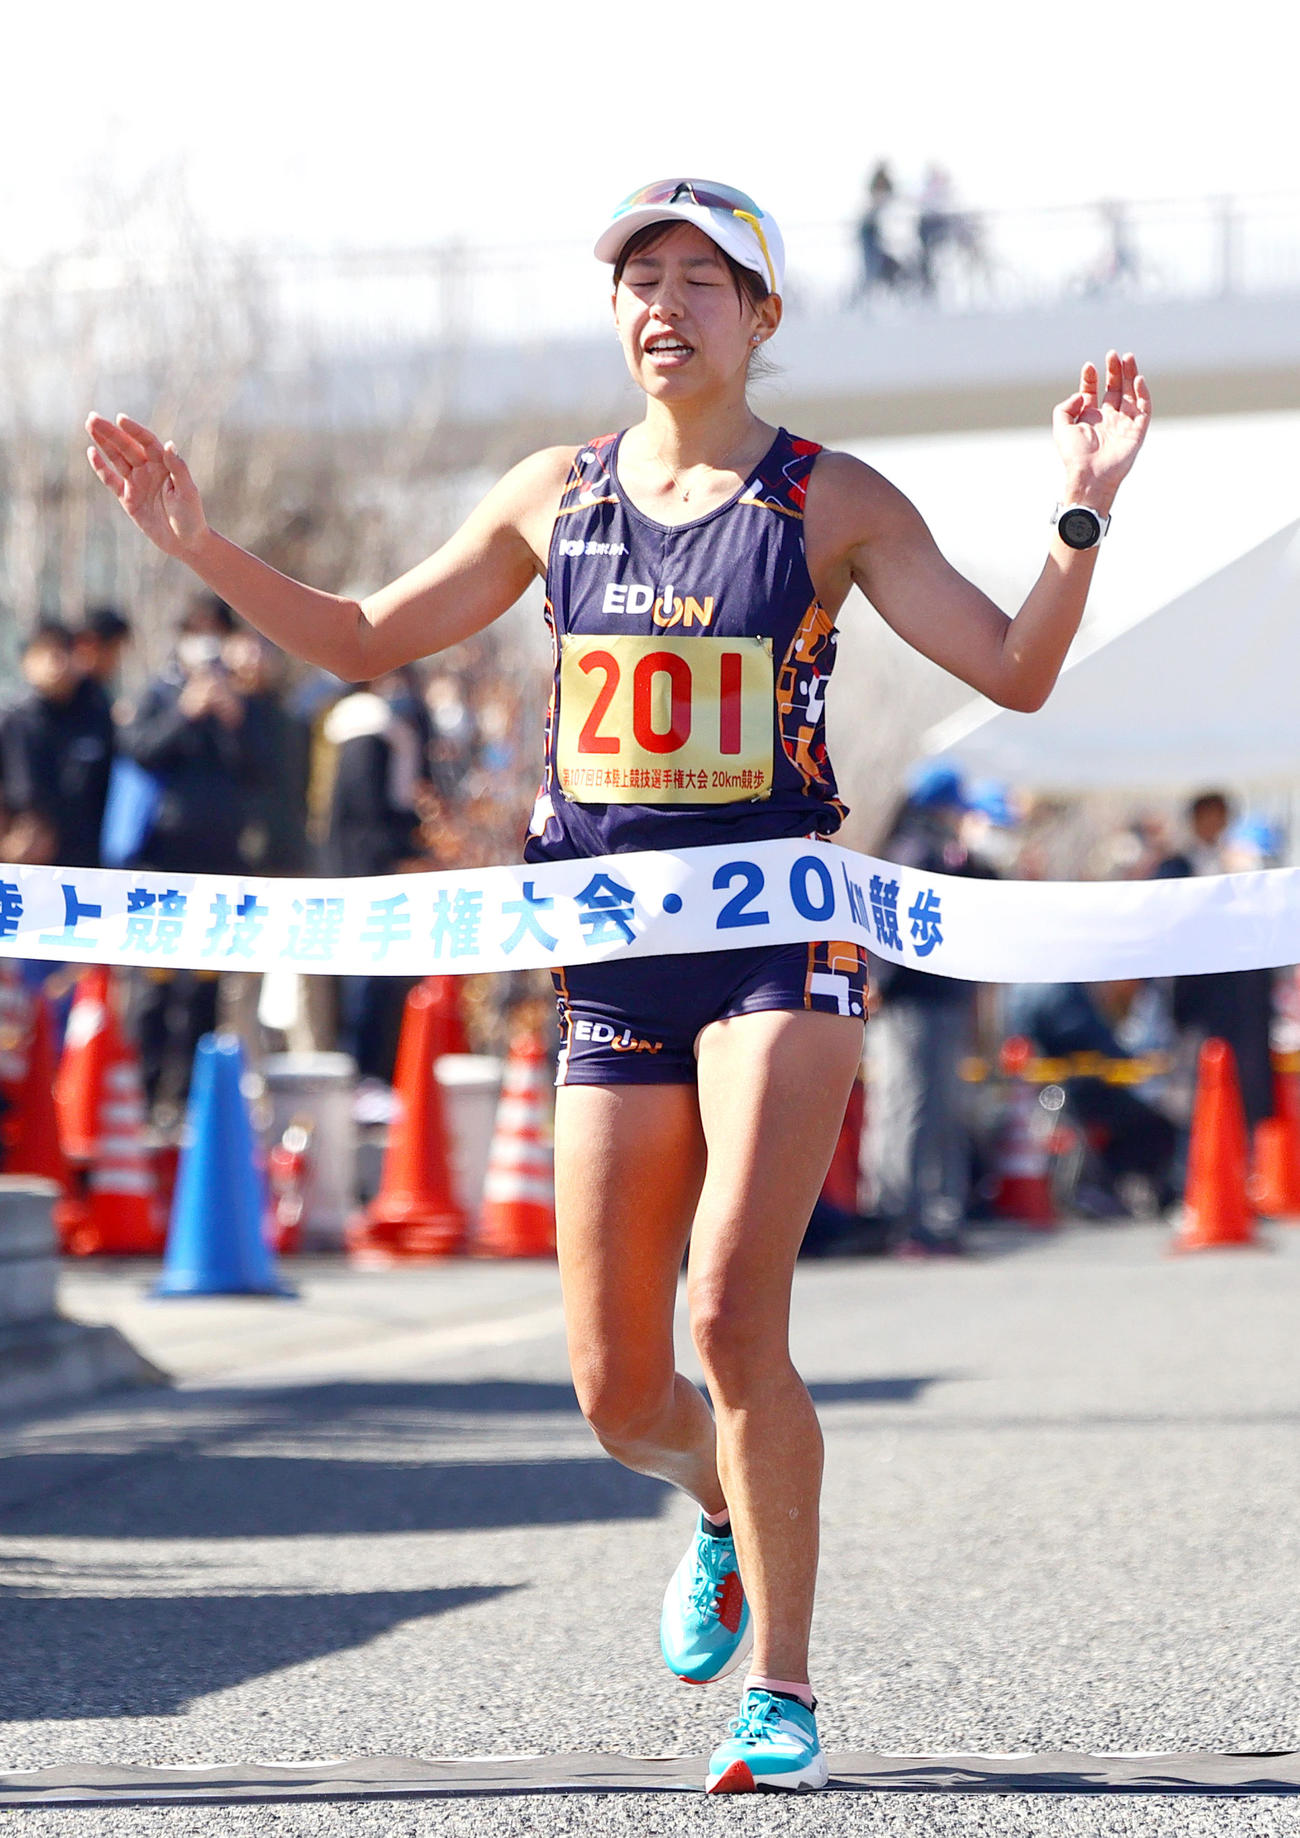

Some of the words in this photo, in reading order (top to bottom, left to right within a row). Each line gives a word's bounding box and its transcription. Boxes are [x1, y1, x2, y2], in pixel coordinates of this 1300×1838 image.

[602, 583, 714, 627] EDION
[577, 650, 742, 755] 201
[563, 768, 708, 790] 第107回日本陸上競技選手権大会
[712, 769, 765, 789] 20km競歩
[575, 1020, 663, 1054] EDION
